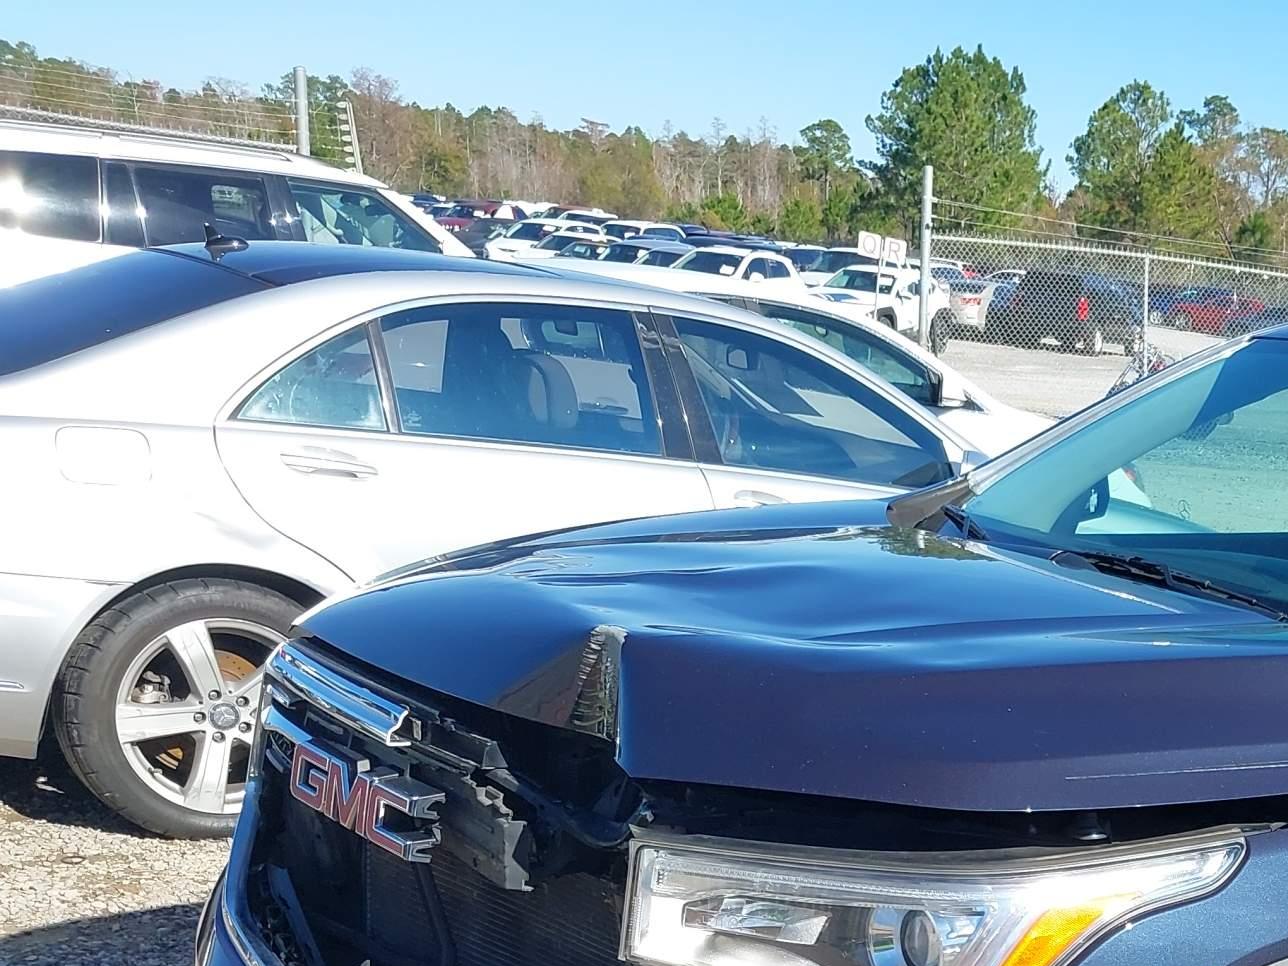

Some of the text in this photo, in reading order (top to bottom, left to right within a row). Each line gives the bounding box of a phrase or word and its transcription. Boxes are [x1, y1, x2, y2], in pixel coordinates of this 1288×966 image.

[862, 234, 877, 255] Q
[888, 240, 901, 261] R
[289, 743, 430, 863] GMC
